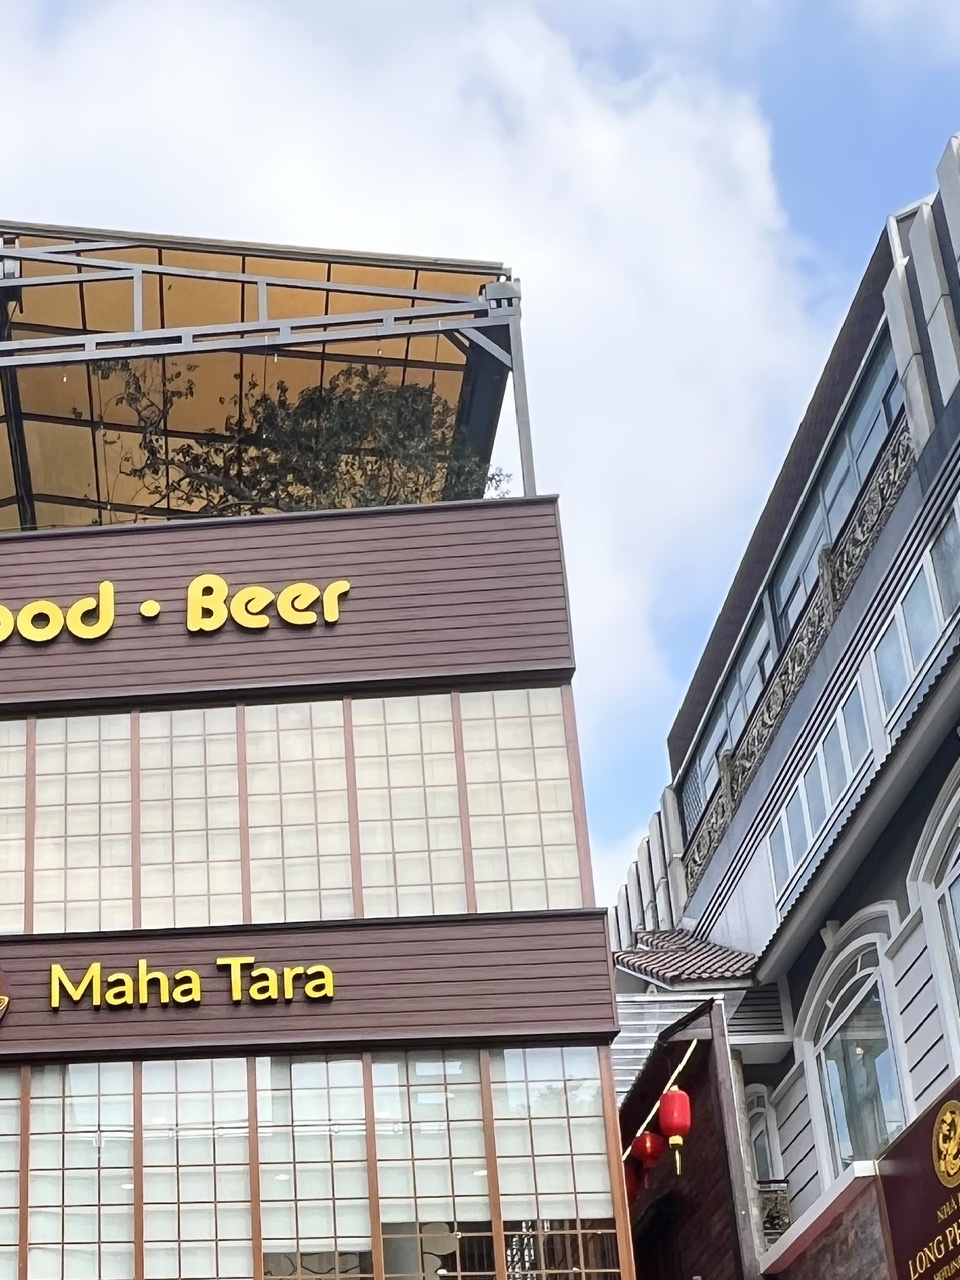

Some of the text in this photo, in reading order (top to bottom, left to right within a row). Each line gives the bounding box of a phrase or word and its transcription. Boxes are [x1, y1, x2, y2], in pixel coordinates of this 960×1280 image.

[185, 573, 350, 632] Beer
[50, 957, 203, 1009] Maha
[217, 955, 335, 1003] Tara
[908, 1235, 945, 1280] LONG
